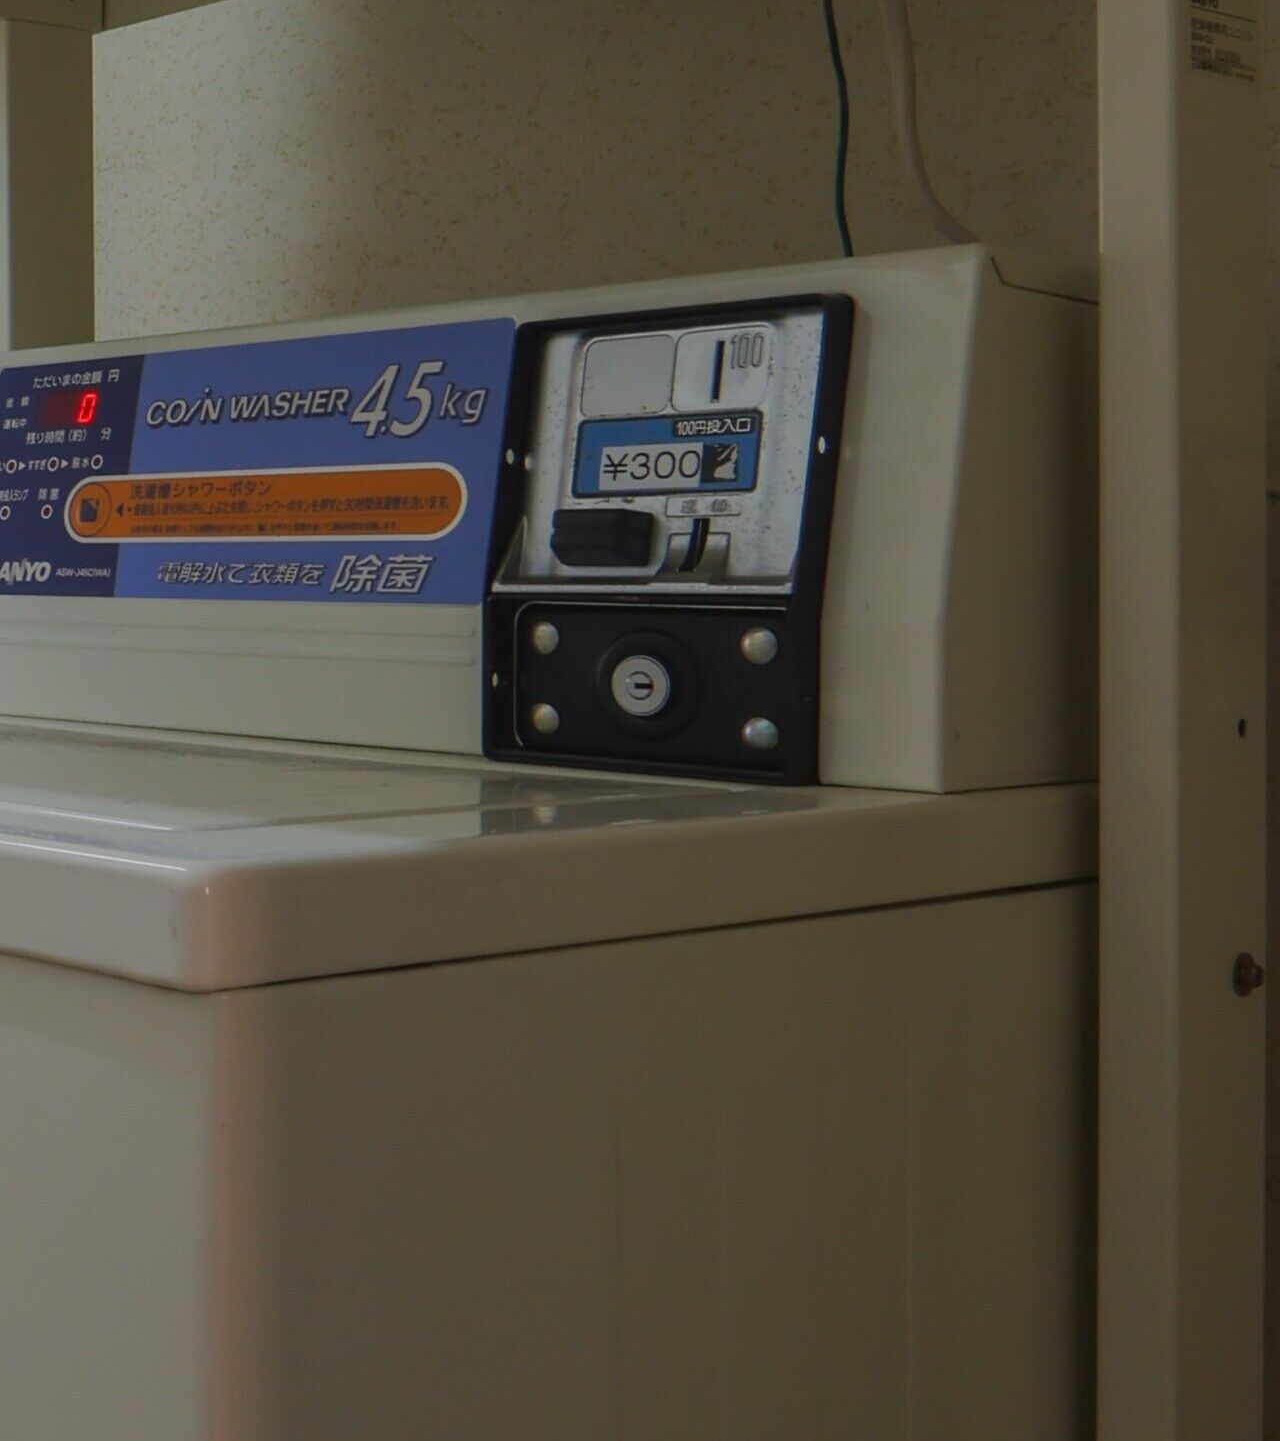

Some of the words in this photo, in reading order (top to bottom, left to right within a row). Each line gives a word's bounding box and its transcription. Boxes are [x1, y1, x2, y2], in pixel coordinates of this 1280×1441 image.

[33, 371, 103, 389] ただいまの金額
[108, 368, 120, 382] 円
[77, 393, 98, 423] 0
[230, 386, 351, 422] WASHER
[440, 382, 487, 425] kg
[100, 426, 112, 440] 分
[676, 417, 751, 436] 100円投入口
[603, 450, 701, 481] ¥300
[329, 553, 436, 595] 除菌
